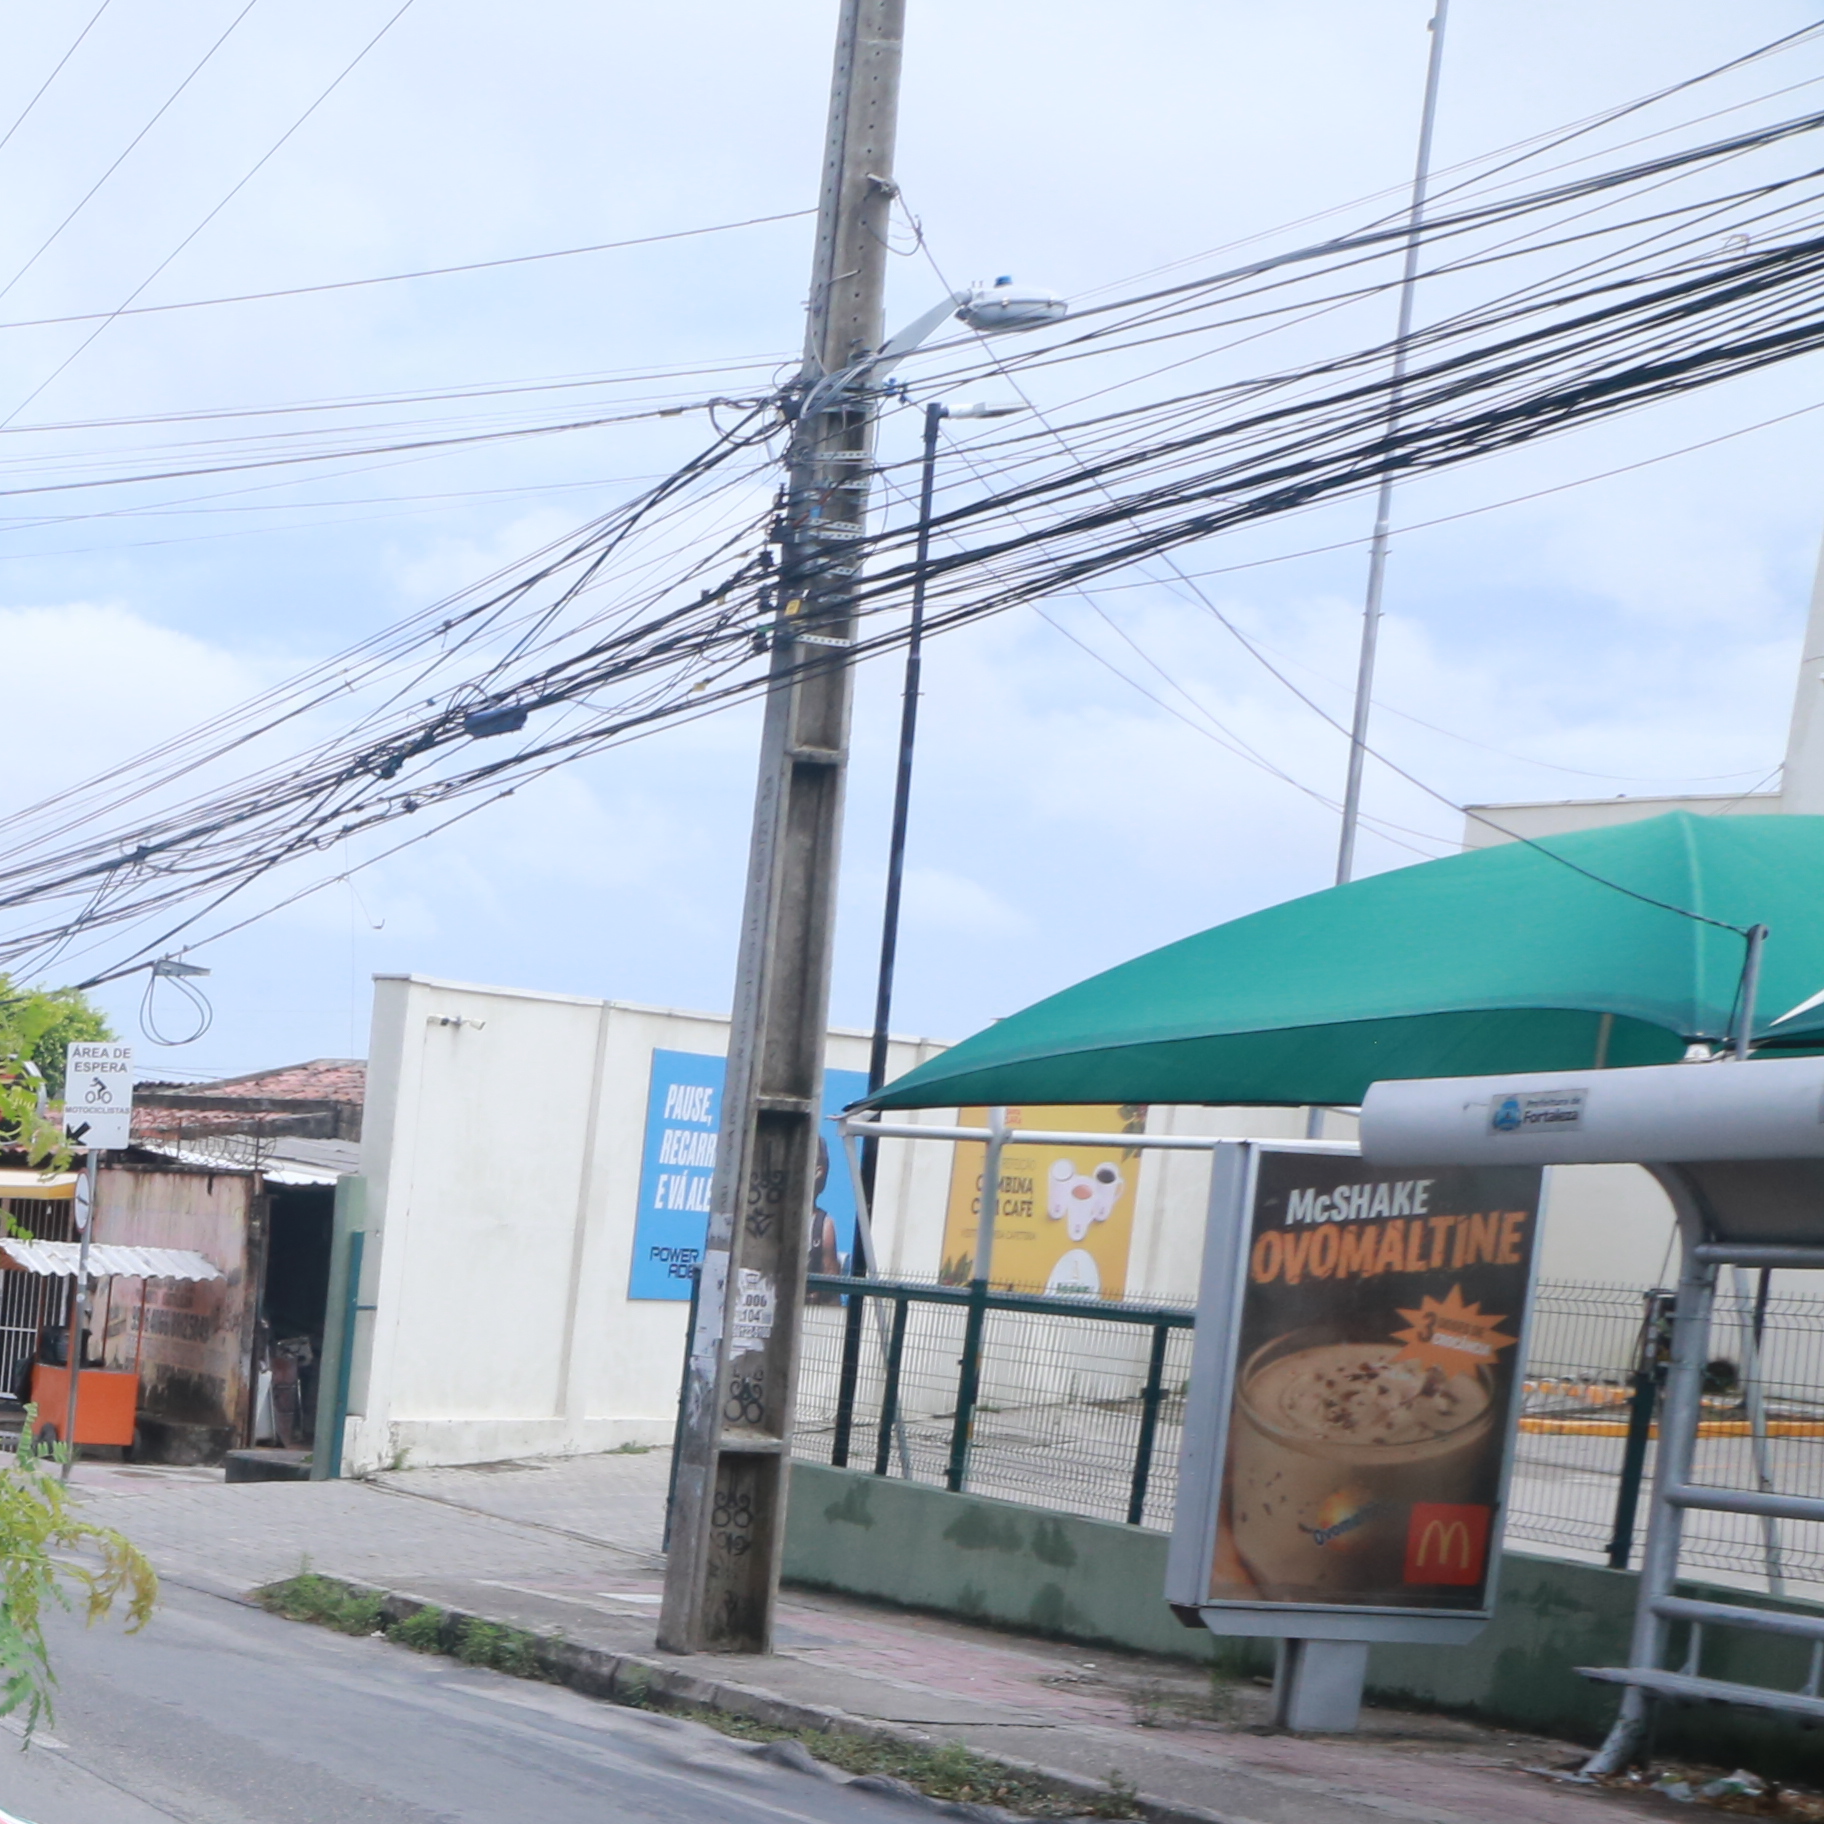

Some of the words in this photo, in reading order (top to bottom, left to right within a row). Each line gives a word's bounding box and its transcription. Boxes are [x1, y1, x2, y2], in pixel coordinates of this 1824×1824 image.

[72, 1044, 109, 1058] ÁREA
[113, 1047, 131, 1059] DE
[74, 1061, 128, 1073] ESPERA
[65, 1106, 130, 1114] MOTOCICLISTAS
[663, 1083, 715, 1127] PAUSE,
[1523, 1108, 1579, 1123] Fortaleza
[658, 1129, 718, 1167] RECARR
[654, 1174, 668, 1209] E
[667, 1170, 689, 1211] VÁ
[685, 1173, 714, 1212] ALÉ
[1285, 1179, 1435, 1225] McSHAKE
[650, 1246, 699, 1263] POWER
[1253, 1210, 1529, 1285] OVOMALTINE
[1417, 1312, 1436, 1343] 3
